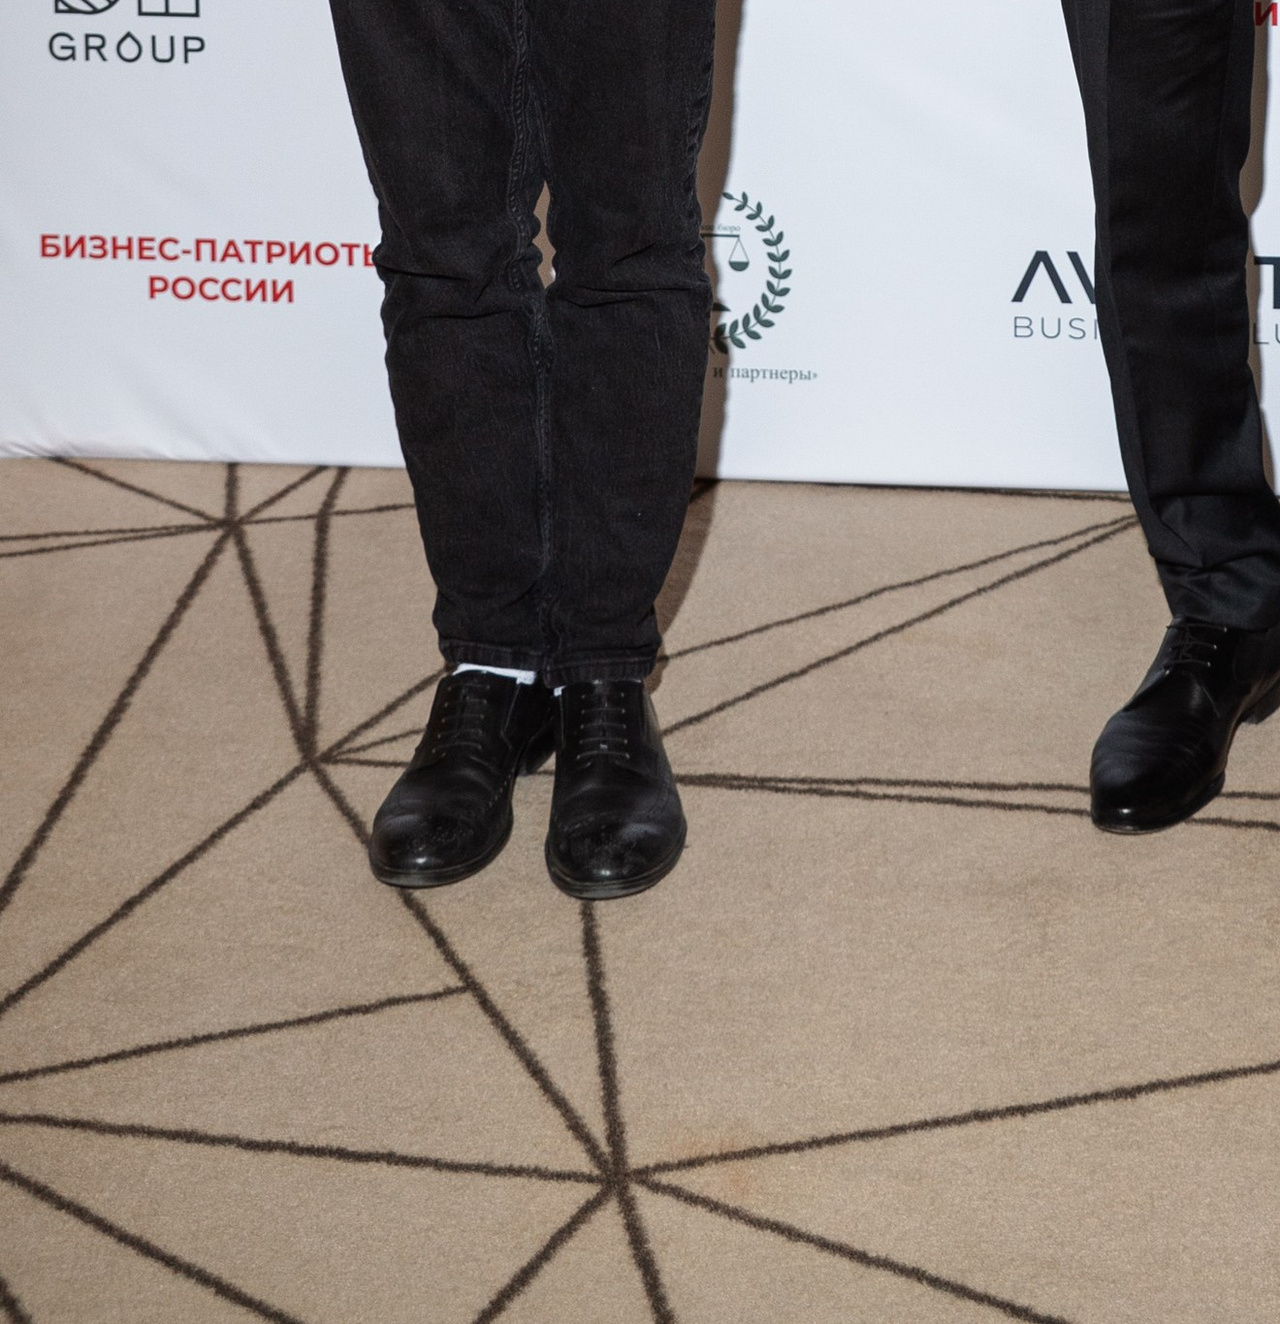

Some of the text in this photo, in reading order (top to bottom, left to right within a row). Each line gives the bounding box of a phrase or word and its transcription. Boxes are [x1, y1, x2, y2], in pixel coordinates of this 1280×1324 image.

[48, 31, 206, 64] GROUP
[149, 275, 295, 303] РОССИИ
[731, 366, 818, 384] партнеры»
